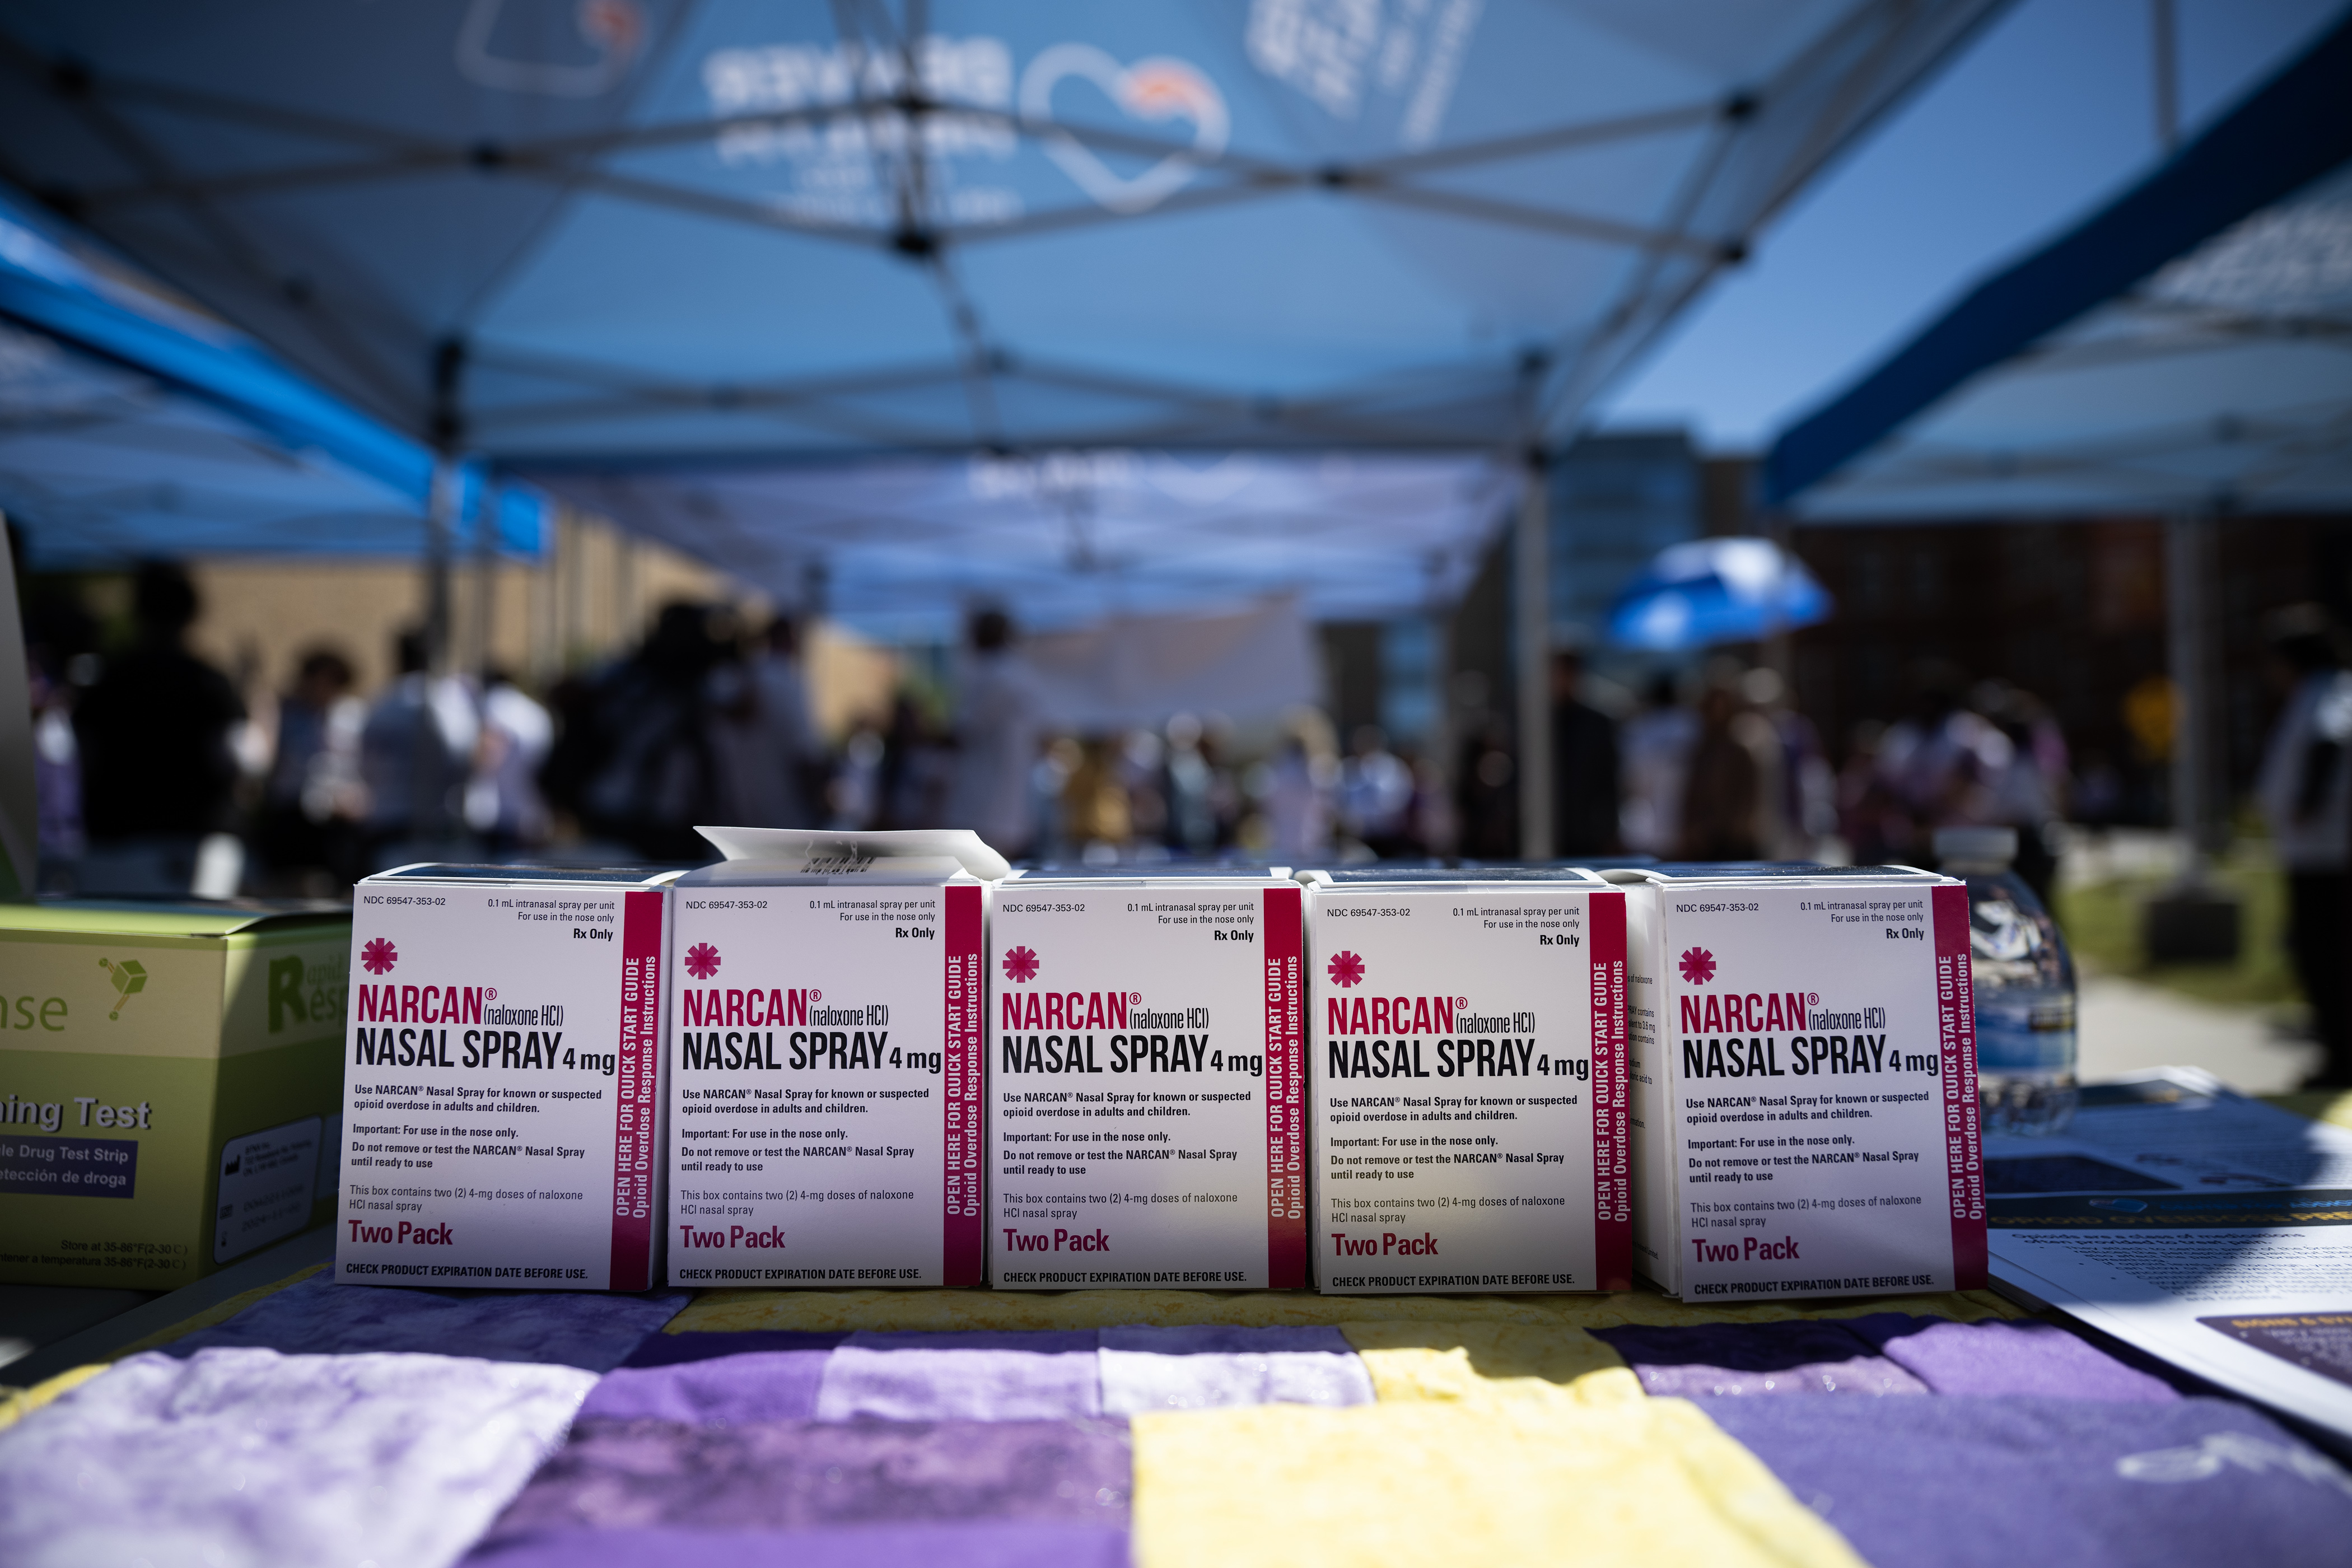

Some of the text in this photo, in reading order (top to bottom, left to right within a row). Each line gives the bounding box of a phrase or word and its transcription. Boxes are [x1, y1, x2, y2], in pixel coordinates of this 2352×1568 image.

[386, 897, 445, 906] 69547-353-02
[488, 899, 498, 907] 0.1
[502, 899, 514, 907] mL
[516, 899, 556, 908] intranasal
[558, 902, 581, 911] spray
[599, 901, 615, 909] unit
[573, 928, 613, 941] Rx Only
[1635, 974, 1653, 984] naloxone
[483, 1004, 563, 1026] (naloxone HCl)
[809, 1005, 888, 1026] (naloxone HCl)
[1130, 1007, 1208, 1029] (naloxone HCl)
[1456, 1012, 1535, 1034] (naloxone HCl)
[1638, 1008, 1654, 1018] contains
[1808, 1007, 1886, 1031] (naloxone HCl)
[1649, 1023, 1655, 1034] mg
[1638, 1035, 1655, 1045] contains
[356, 1027, 615, 1076] NASAL SPRAY 4 mg
[683, 1031, 941, 1074] NASAL SPRAY 4 mg
[1003, 1034, 1262, 1077] NASAL SPRAY 4 mg
[1329, 1038, 1588, 1081] NASAL SPRAY 4 mg
[1683, 1034, 1939, 1078] NASAL SPRAY 4 mg
[1284, 956, 1302, 1219] Opioid Overdose Response Instructions
[1639, 1074, 1648, 1084] acid
[1939, 956, 1966, 1218] OPEN HERE FOR QUICK START GUIDE
[683, 1089, 700, 1099] Use
[754, 1089, 782, 1099] Nasal
[785, 1089, 813, 1101] Spray
[815, 1089, 829, 1098] for
[831, 1089, 864, 1098] known
[879, 1088, 928, 1100] suspected
[0, 1094, 152, 1133] ing Test
[0, 1144, 129, 1165] le Drug Test Strip
[62, 1170, 80, 1184] de
[85, 1170, 127, 1189] droga
[1331, 1196, 1565, 1208] This box contains two (2) 4-mg doses of naloxone
[2110, 1214, 2292, 1224] OVERDOSE
[348, 1219, 453, 1245] Two Pack
[680, 1225, 786, 1248] Two Pack
[1002, 1228, 1110, 1252] Two Pack
[60, 1239, 88, 1251] Store
[91, 1242, 101, 1251] at
[1331, 1232, 1438, 1256] Two Pack
[1691, 1235, 1800, 1262] Two Pack
[32, 1255, 38, 1263] a
[41, 1254, 101, 1267] temperatura
[1004, 1271, 1247, 1282] CHECK PRODUCT EXPIRATION DATE BEFORE USE.
